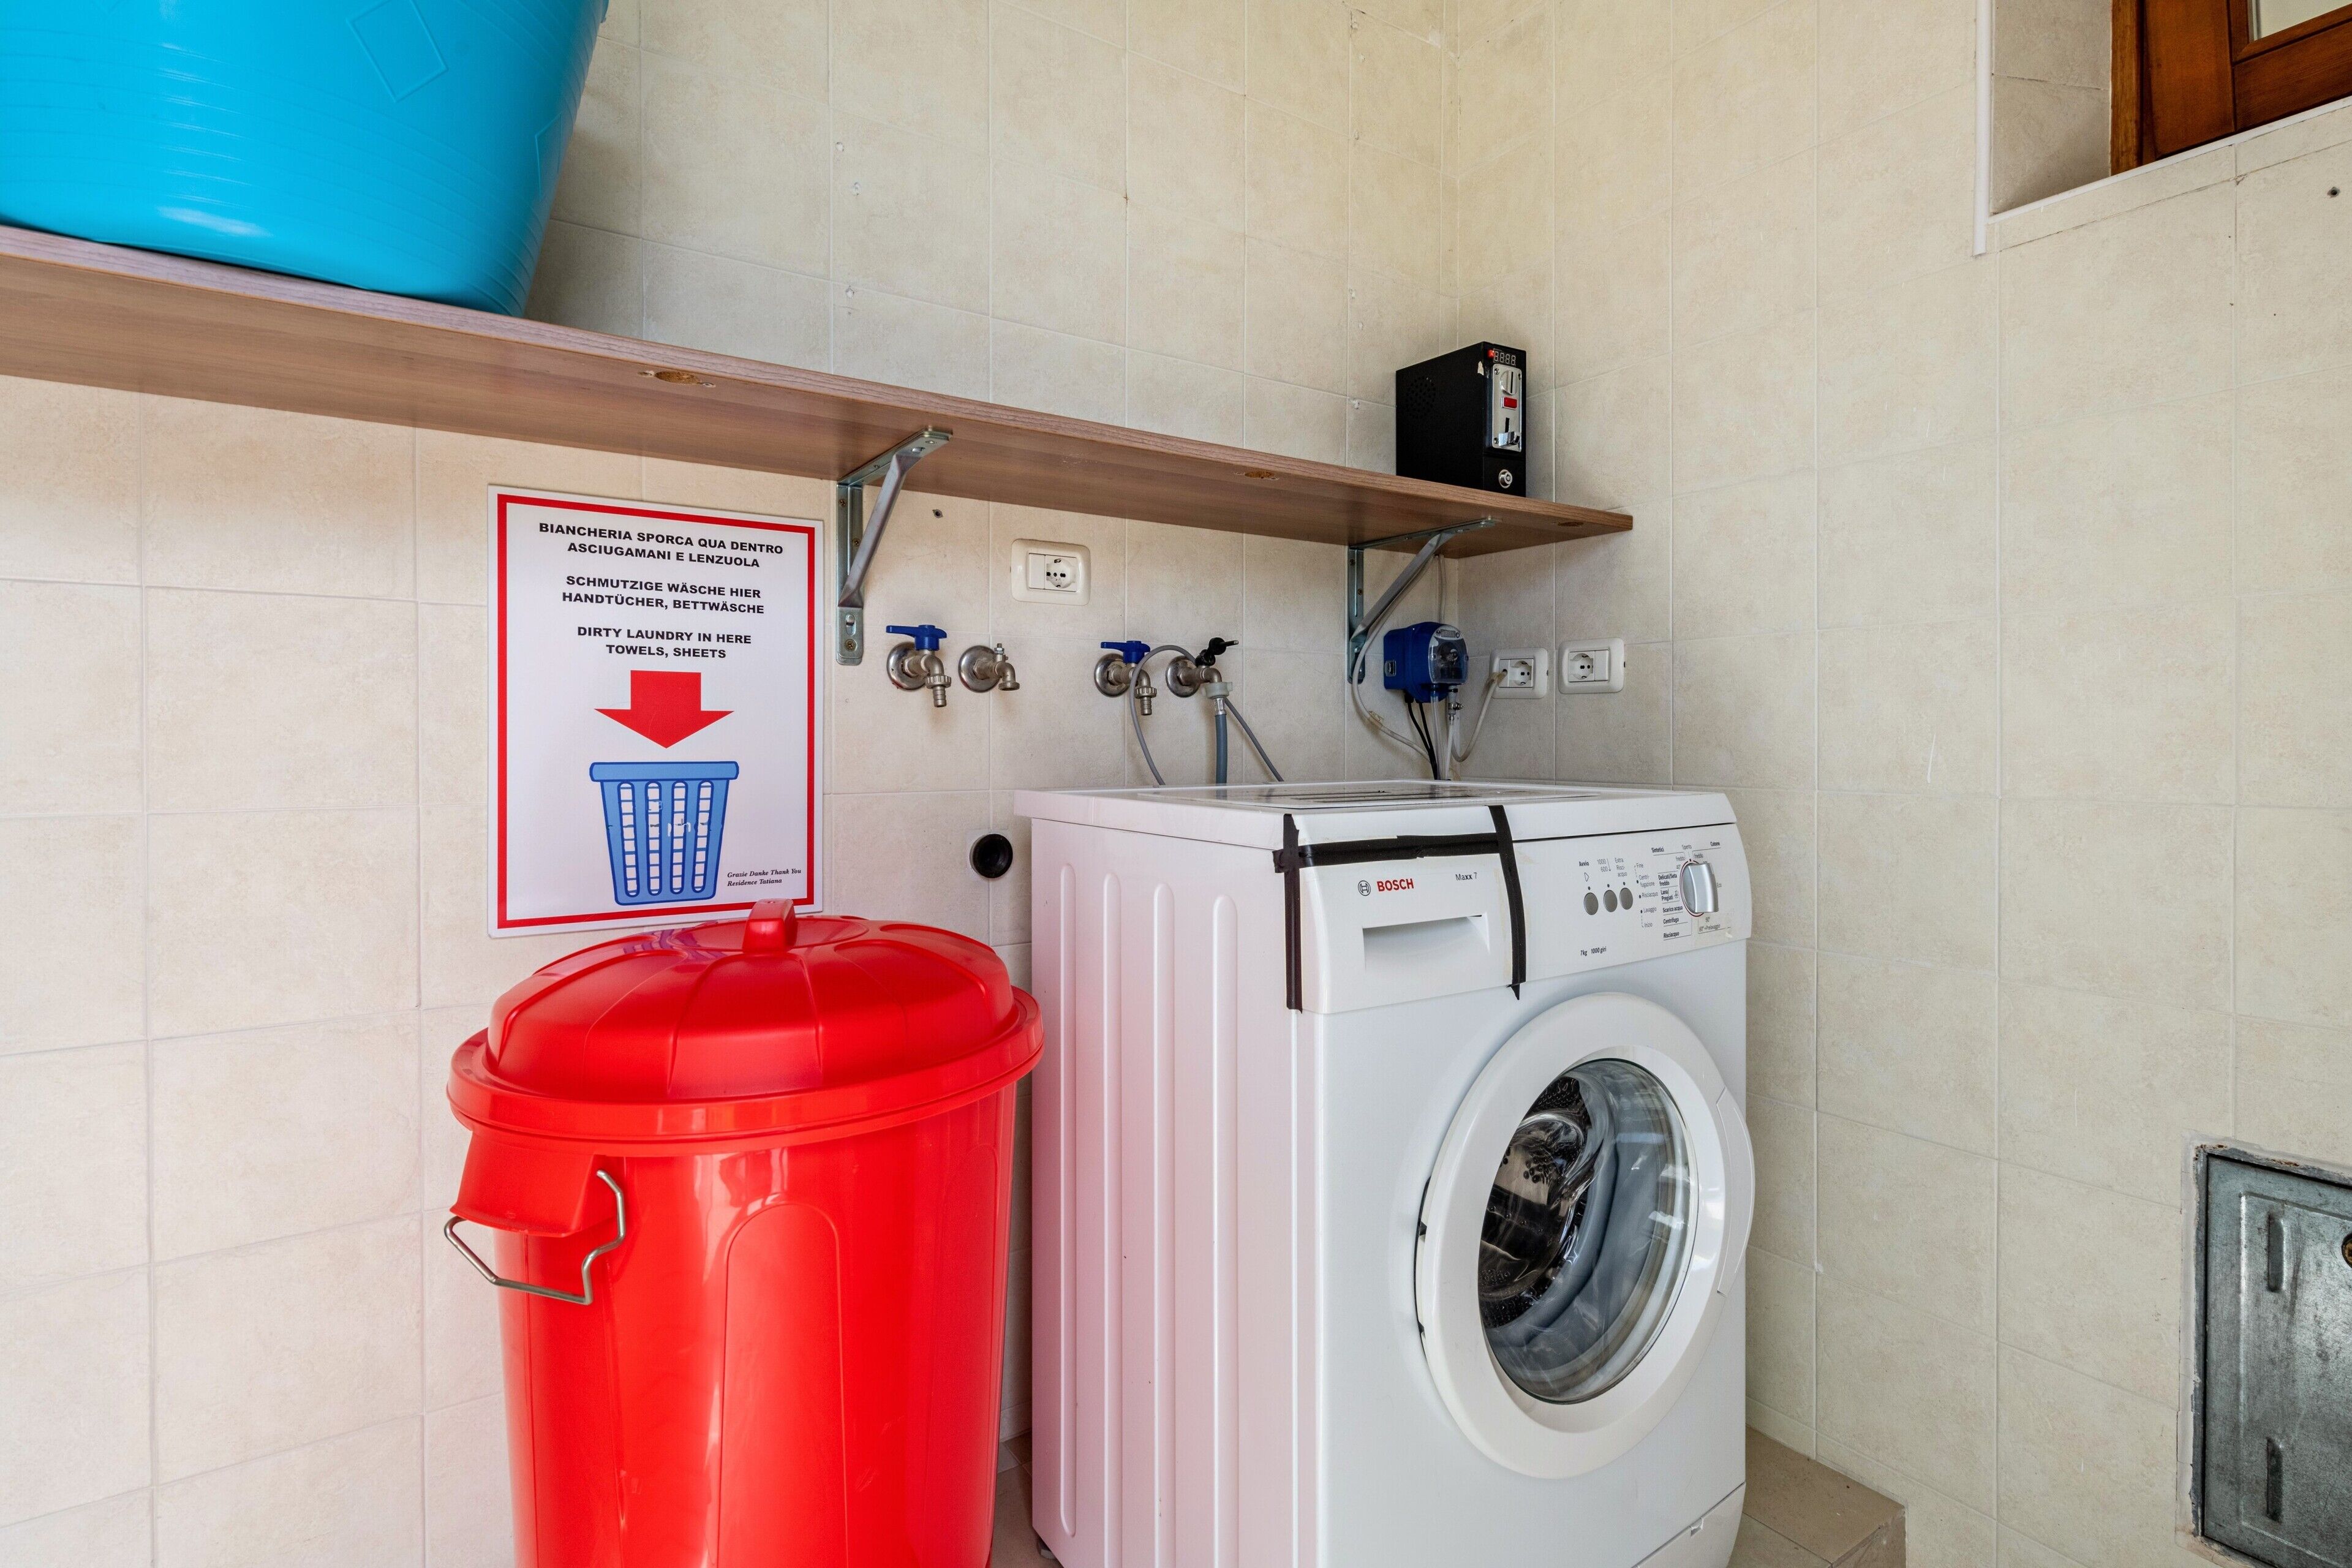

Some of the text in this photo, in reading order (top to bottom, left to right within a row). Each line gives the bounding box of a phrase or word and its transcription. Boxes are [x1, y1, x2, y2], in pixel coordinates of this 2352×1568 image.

[539, 522, 783, 554] BIANCHERIA SPORCA QUA DENTRO
[568, 542, 760, 567] ASCIUGAMANI E LENZUOLA
[566, 575, 761, 598] SCHMUTZIGE WÄSCHE HIER
[562, 592, 764, 614] HANDTÜCHER, BETTWÄSCHE
[577, 626, 752, 644] DIRTY LAUNDRY IN HERE
[606, 644, 726, 658] TOWELS, SHEETS
[1377, 878, 1414, 892] BOSCH
